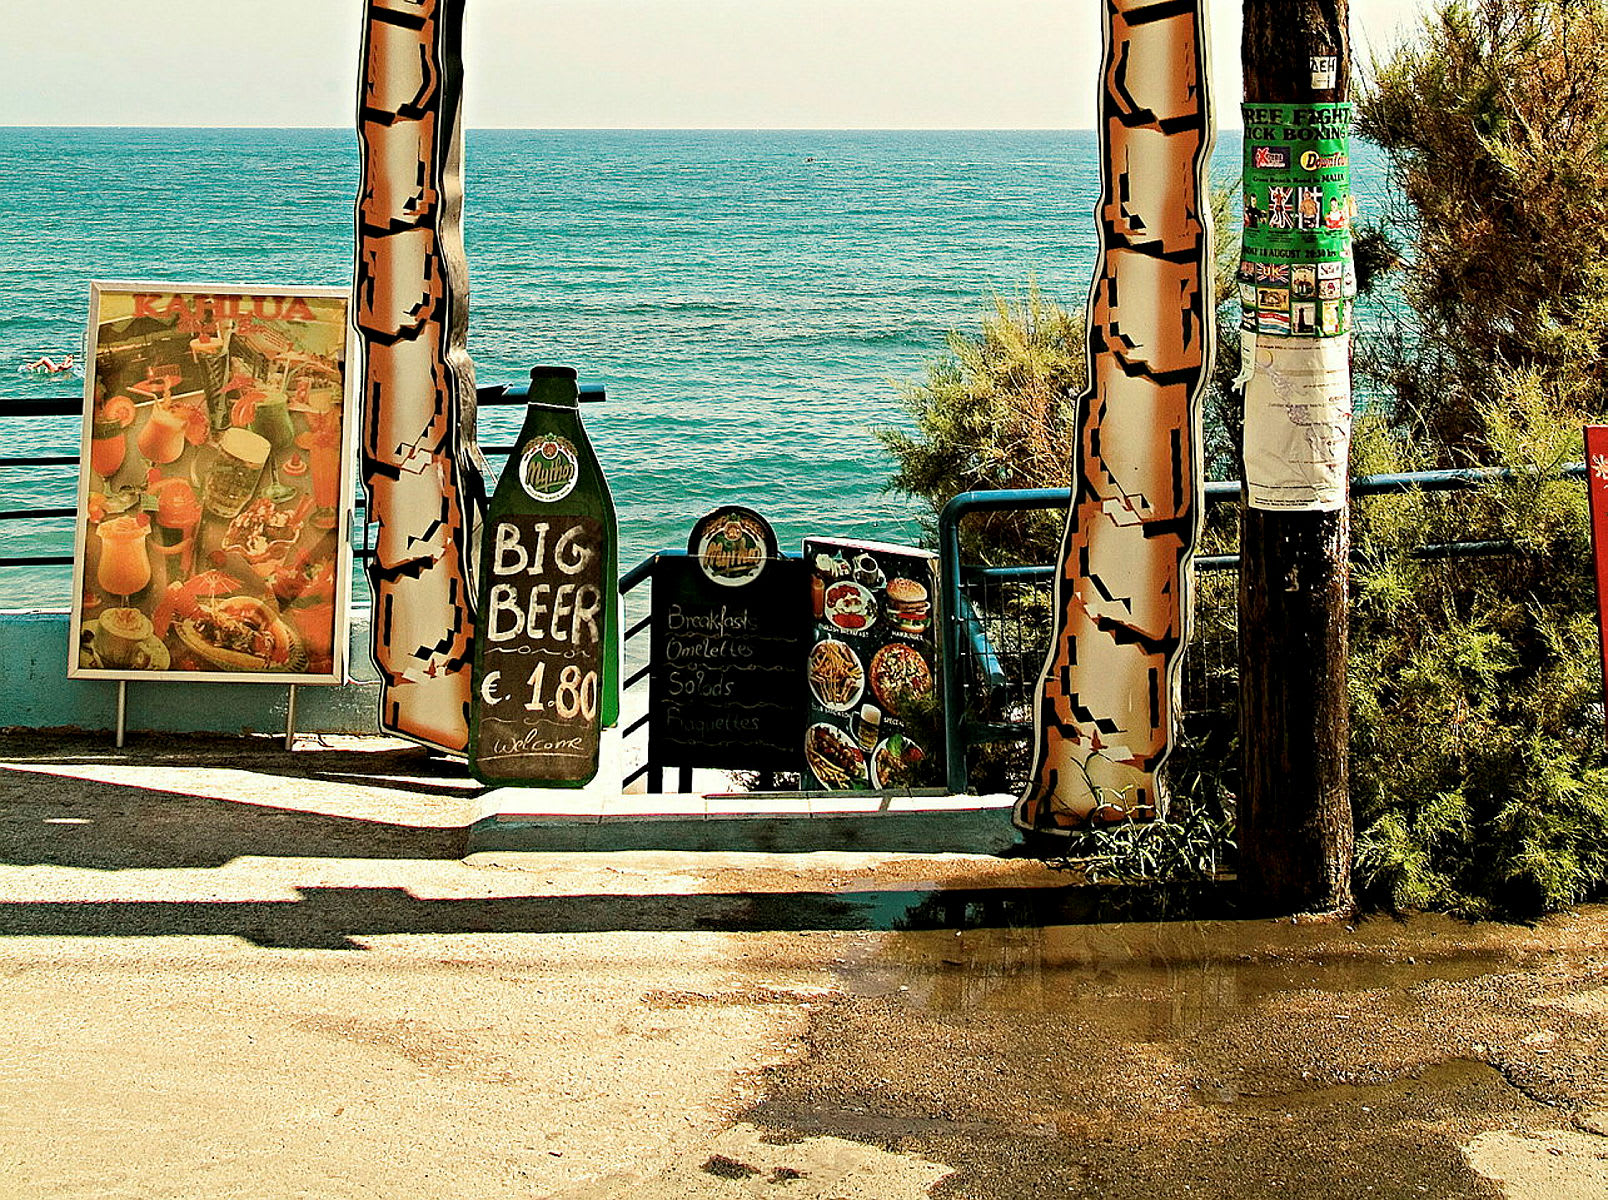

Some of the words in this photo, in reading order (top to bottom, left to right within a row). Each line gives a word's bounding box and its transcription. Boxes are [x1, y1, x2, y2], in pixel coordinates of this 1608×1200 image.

[1243, 108, 1283, 125] REE
[132, 293, 316, 321] KAHLUA
[493, 522, 591, 576] BIG
[487, 583, 600, 647] BEER
[524, 661, 598, 721] 1.80
